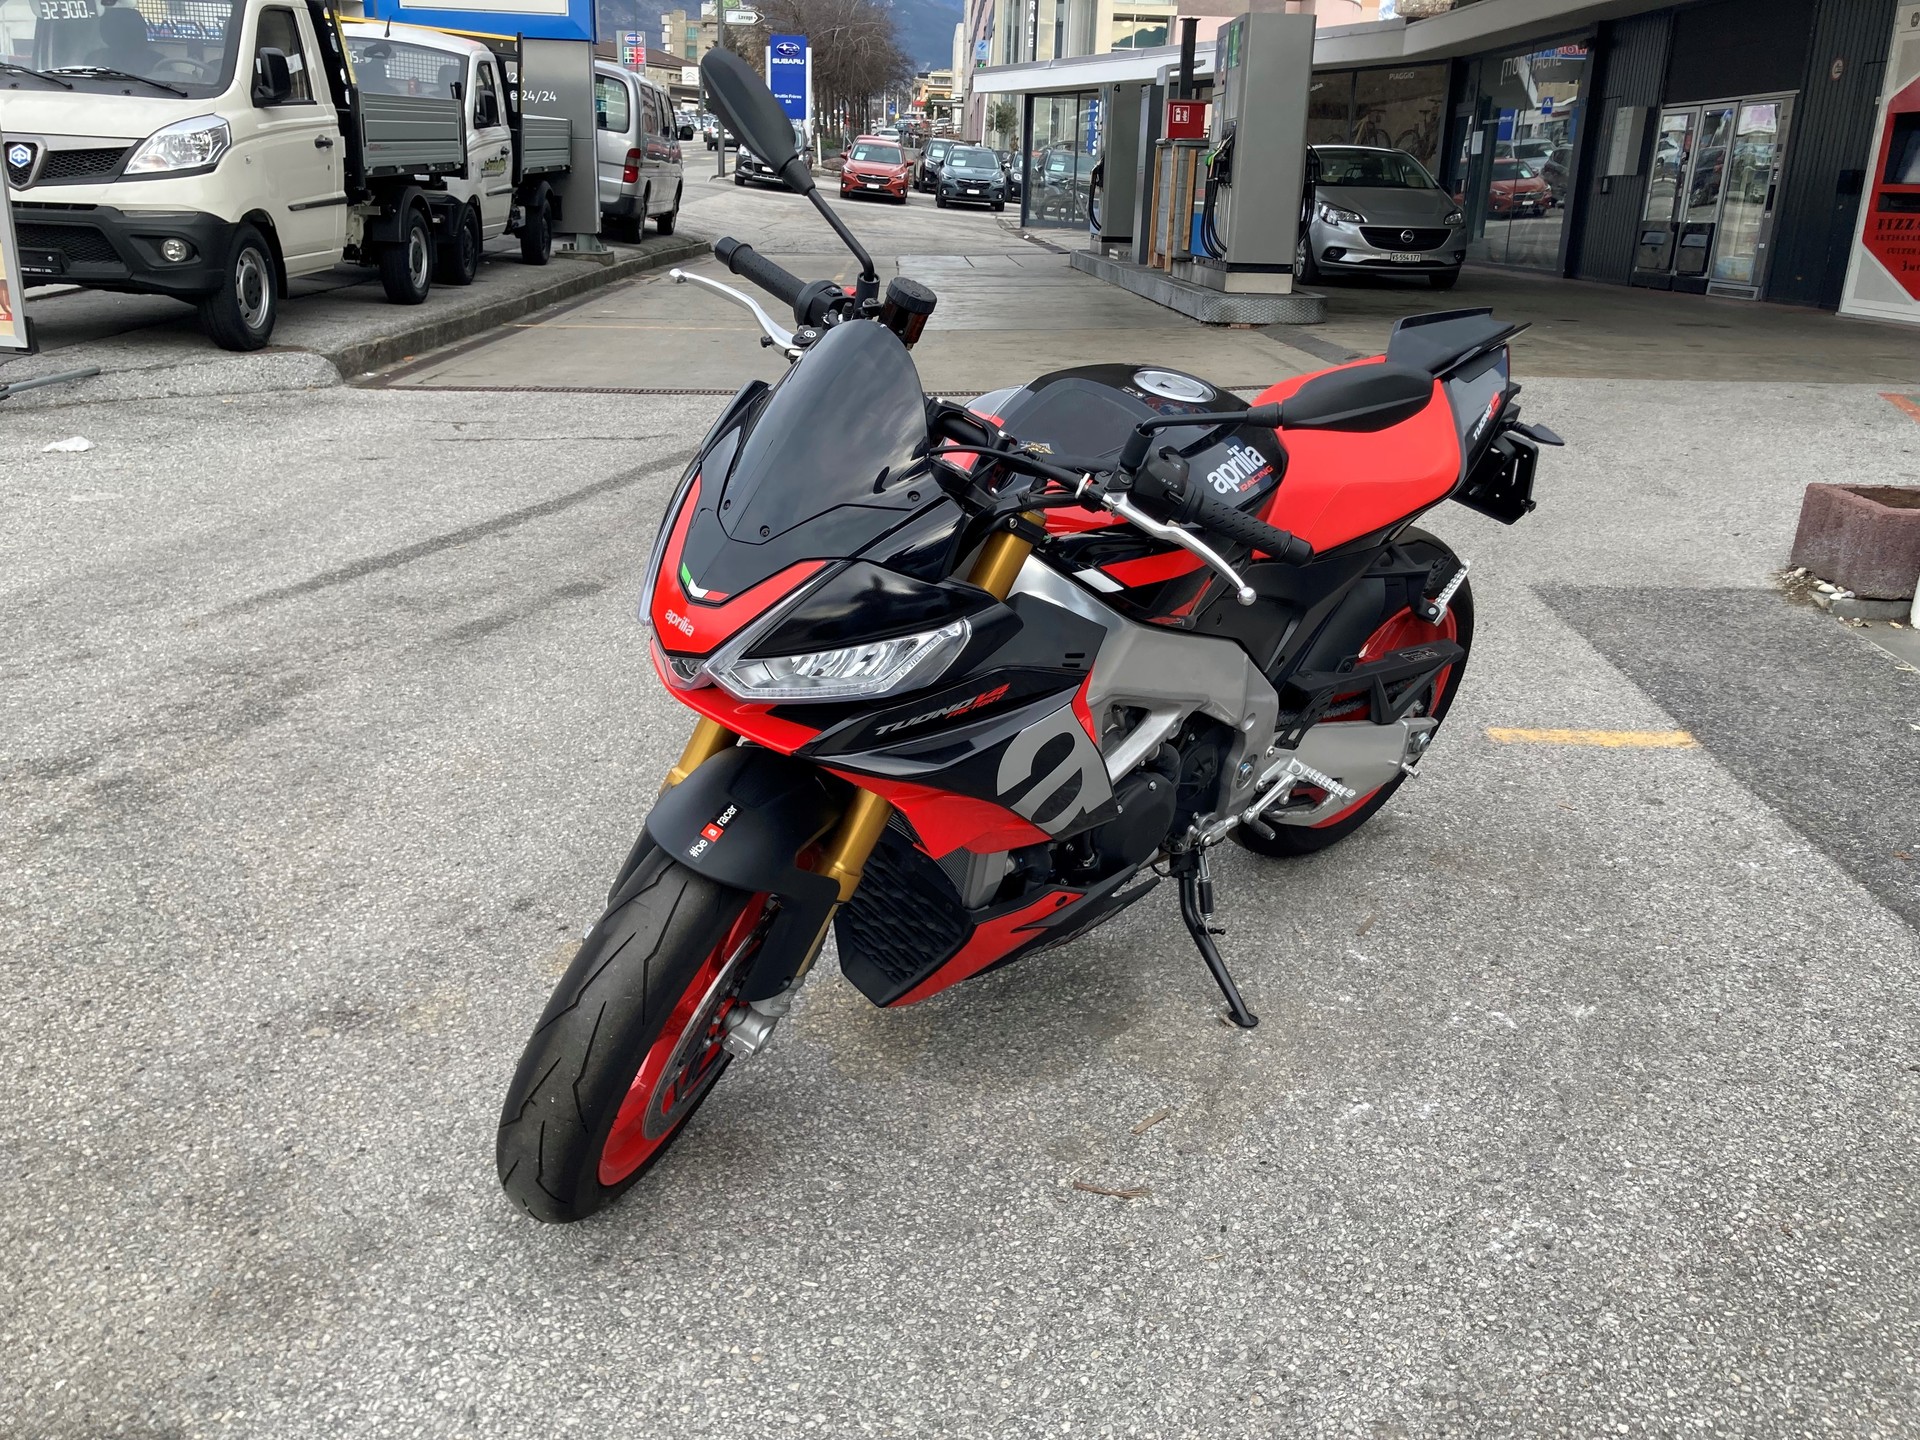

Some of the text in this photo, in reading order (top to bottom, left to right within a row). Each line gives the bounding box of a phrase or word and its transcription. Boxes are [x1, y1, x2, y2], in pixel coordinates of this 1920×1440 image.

[1113, 83, 1121, 93] 4
[1388, 71, 1415, 80] PIAGGIO
[1206, 444, 1267, 494] aprilia
[1240, 464, 1274, 492] RACING
[664, 608, 695, 638] aprilia
[875, 696, 978, 736] TUONO
[688, 804, 738, 858] #be a racer
